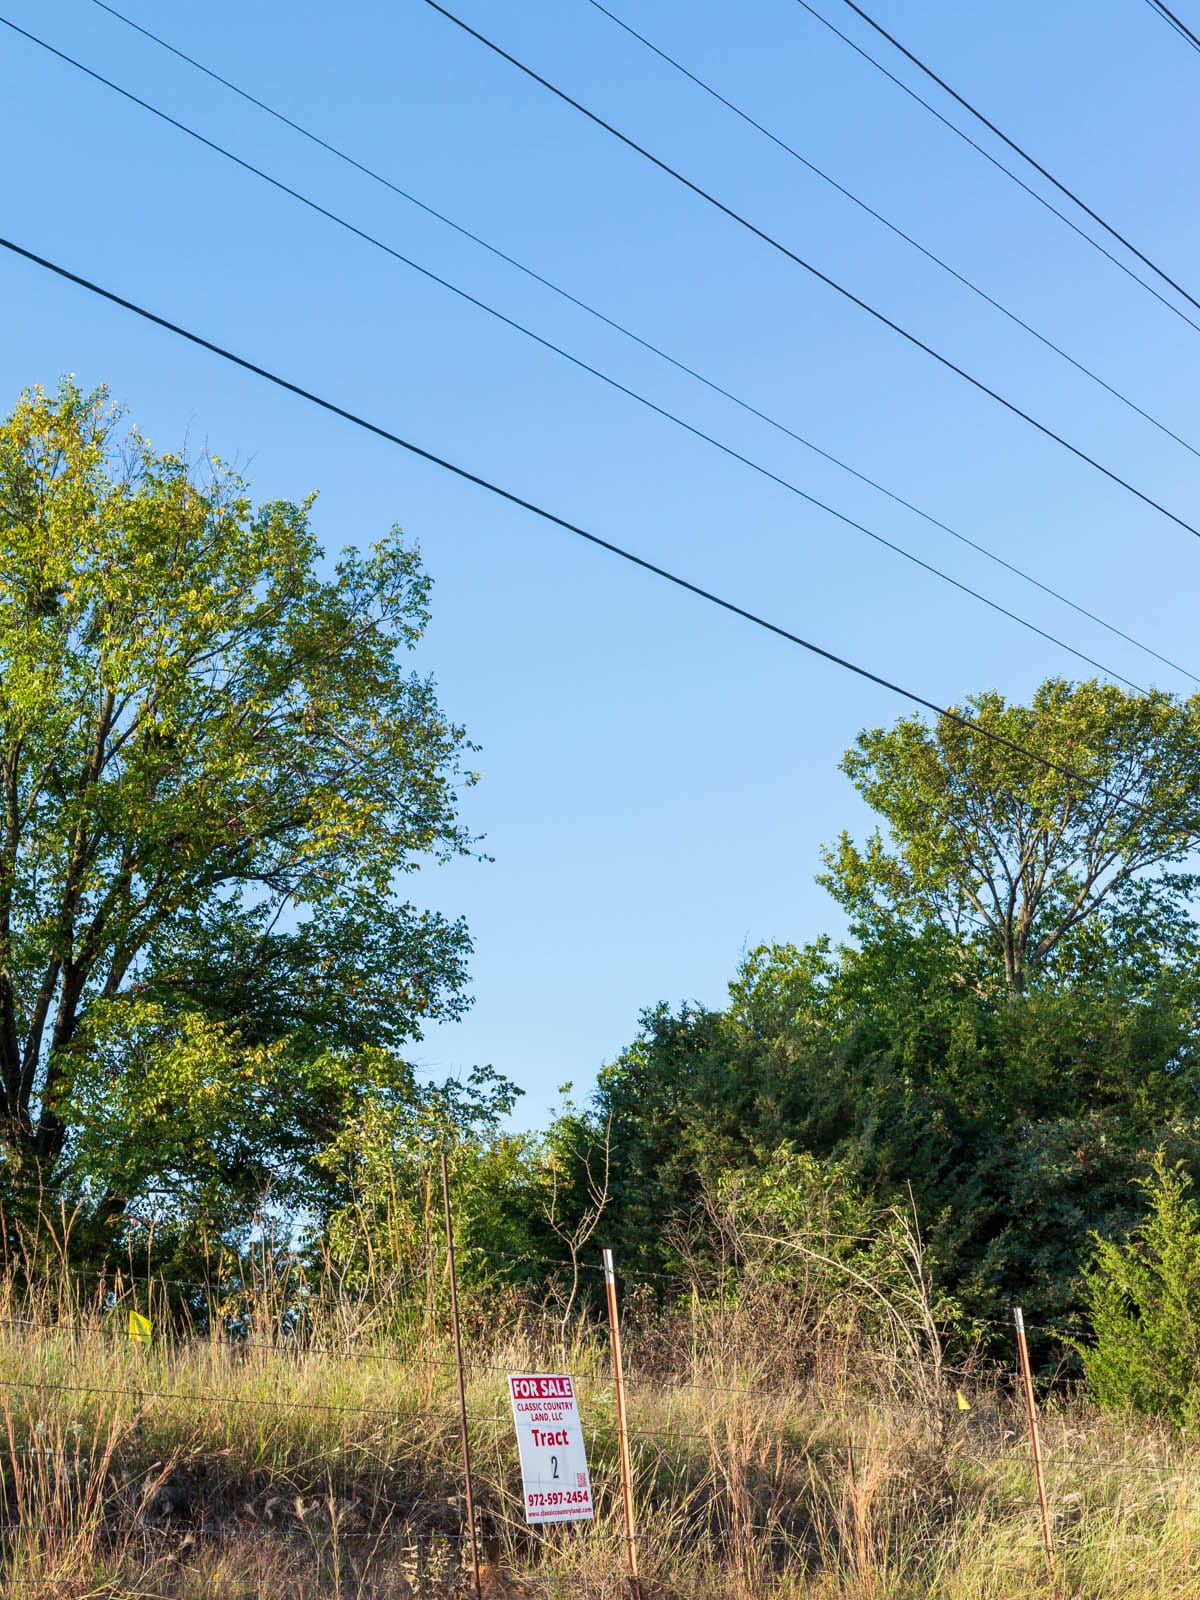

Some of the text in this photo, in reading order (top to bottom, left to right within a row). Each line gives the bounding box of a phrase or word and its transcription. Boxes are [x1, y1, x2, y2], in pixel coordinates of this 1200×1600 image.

[513, 1379, 572, 1397] FOR SALE
[517, 1401, 573, 1411] CLASSIC COUNTRY
[531, 1412, 563, 1422] LAND, LLC
[531, 1429, 569, 1446] Tract
[551, 1456, 559, 1479] 2
[528, 1490, 589, 1506] 972-597-2454
